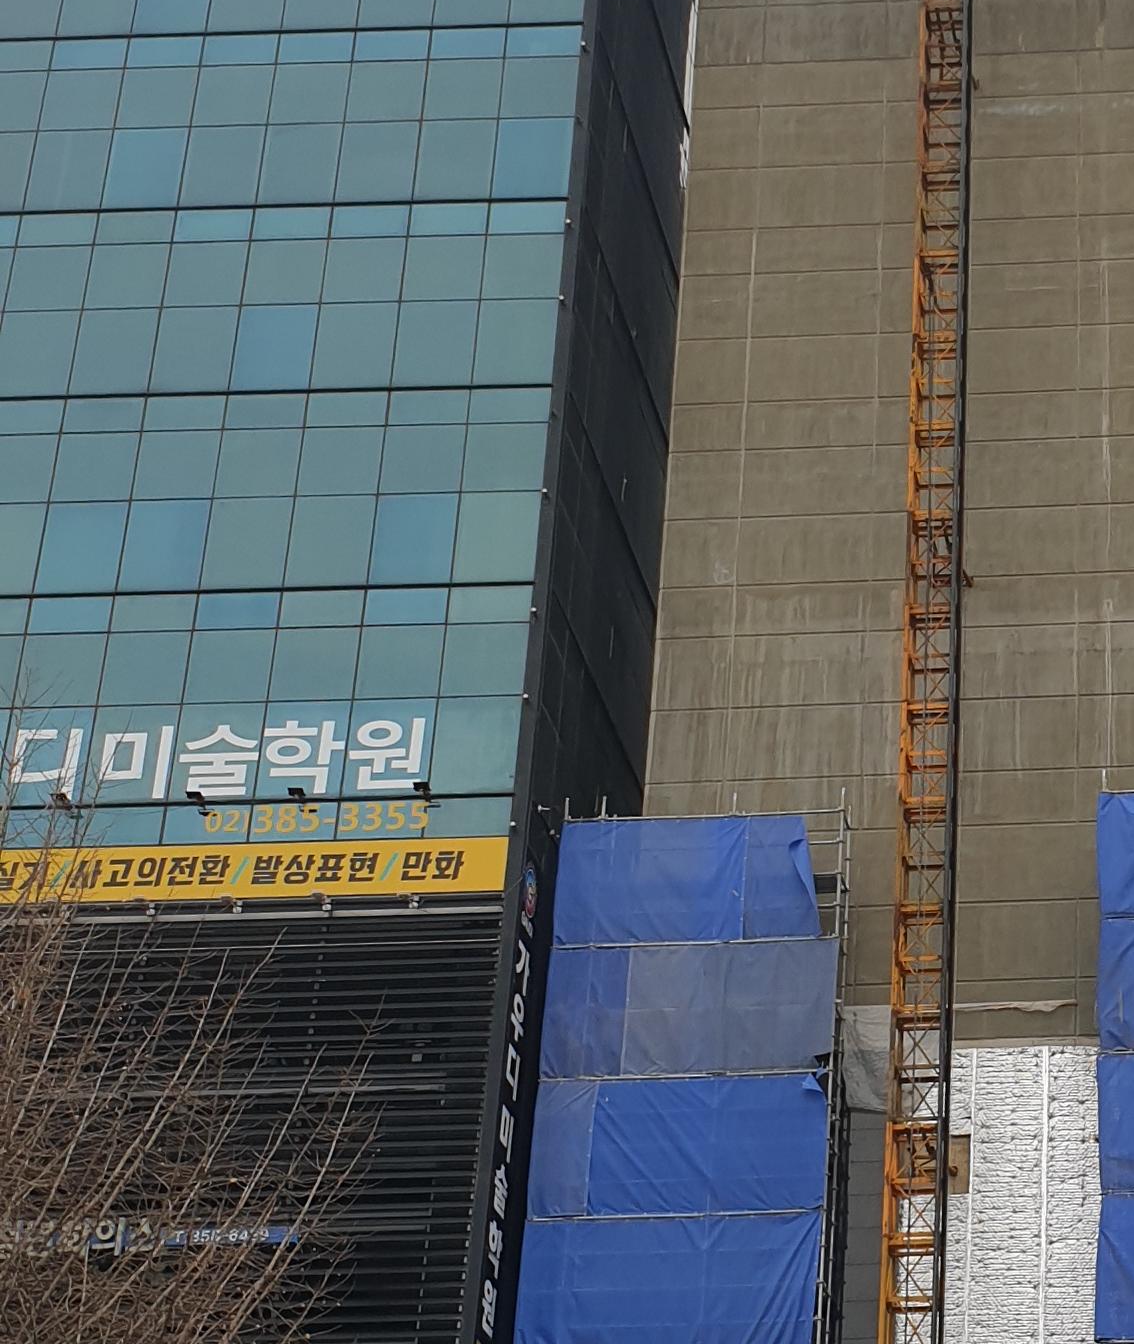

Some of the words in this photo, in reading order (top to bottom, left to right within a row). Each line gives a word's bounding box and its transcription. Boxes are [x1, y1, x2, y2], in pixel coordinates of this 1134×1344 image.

[11, 717, 427, 801] 디미술학원
[252, 851, 380, 885] 발상표현
[401, 850, 464, 882] 만화
